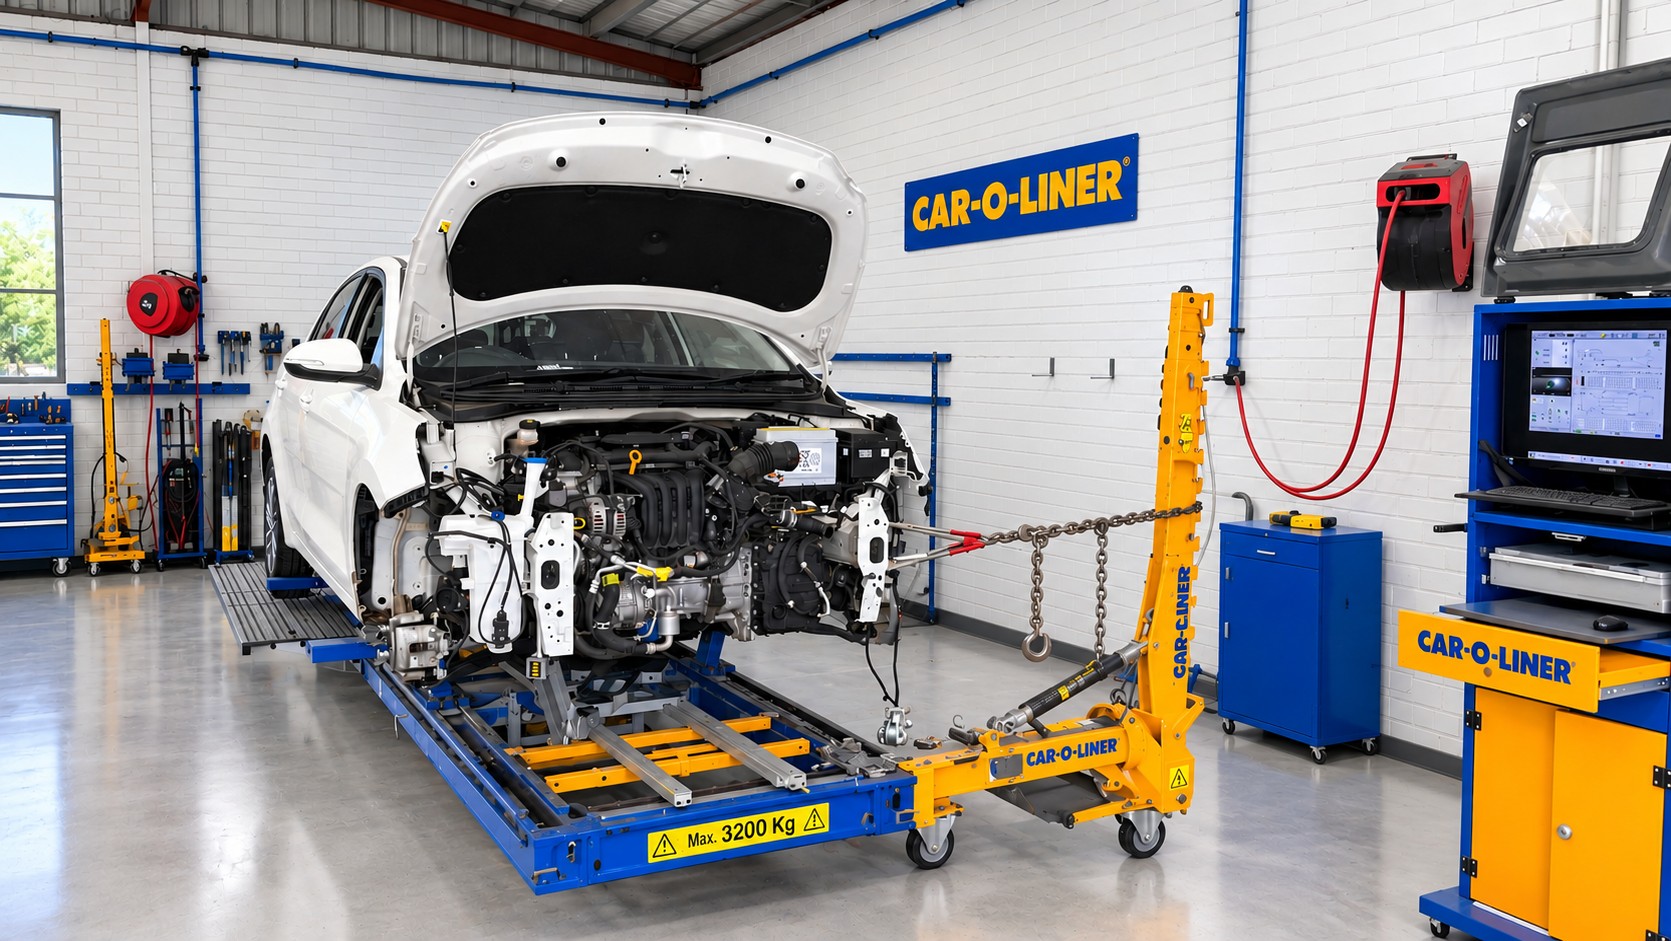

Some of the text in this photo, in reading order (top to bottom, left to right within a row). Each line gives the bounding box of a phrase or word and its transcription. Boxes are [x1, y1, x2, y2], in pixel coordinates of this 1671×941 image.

[1417, 630, 1571, 685] CAR-O-LINER
[688, 816, 796, 848] Max. 3200 Kg
